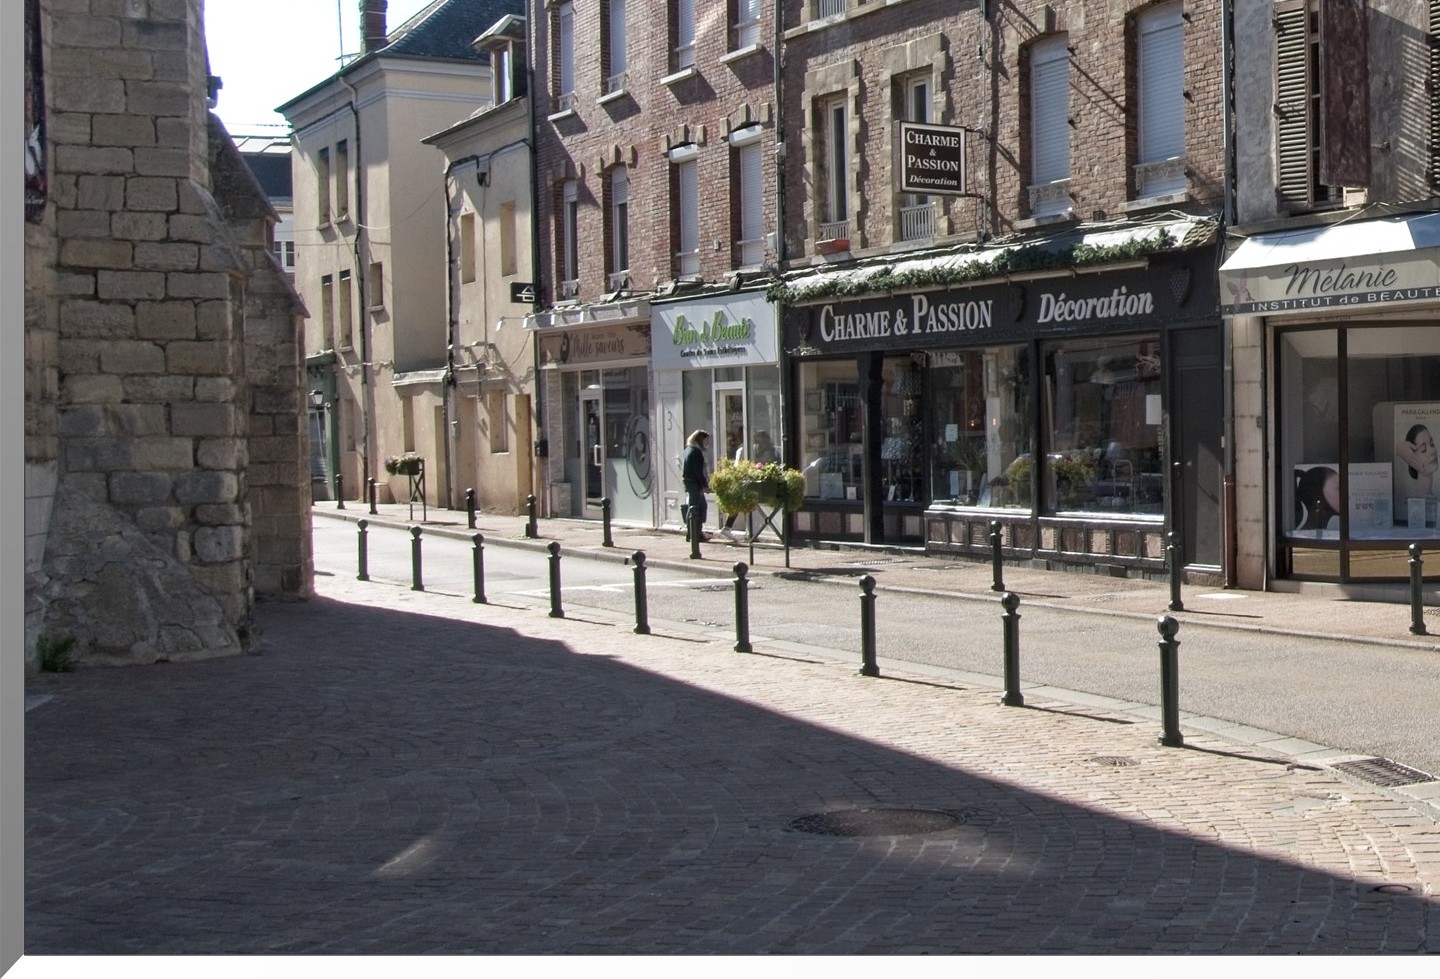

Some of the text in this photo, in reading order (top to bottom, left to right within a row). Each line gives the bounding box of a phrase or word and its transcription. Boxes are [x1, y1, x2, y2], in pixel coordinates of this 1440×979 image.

[906, 130, 959, 148] CHARME
[929, 148, 937, 157] &
[907, 154, 959, 172] PASSION
[909, 174, 958, 186] Décoration
[1284, 263, 1399, 296] Mélanie
[1037, 285, 1155, 323] Décoration
[1251, 297, 1333, 312] INSTITUT
[1339, 294, 1360, 305] de
[711, 308, 752, 342] Beauté
[820, 294, 994, 342] CHARME & PASSION
